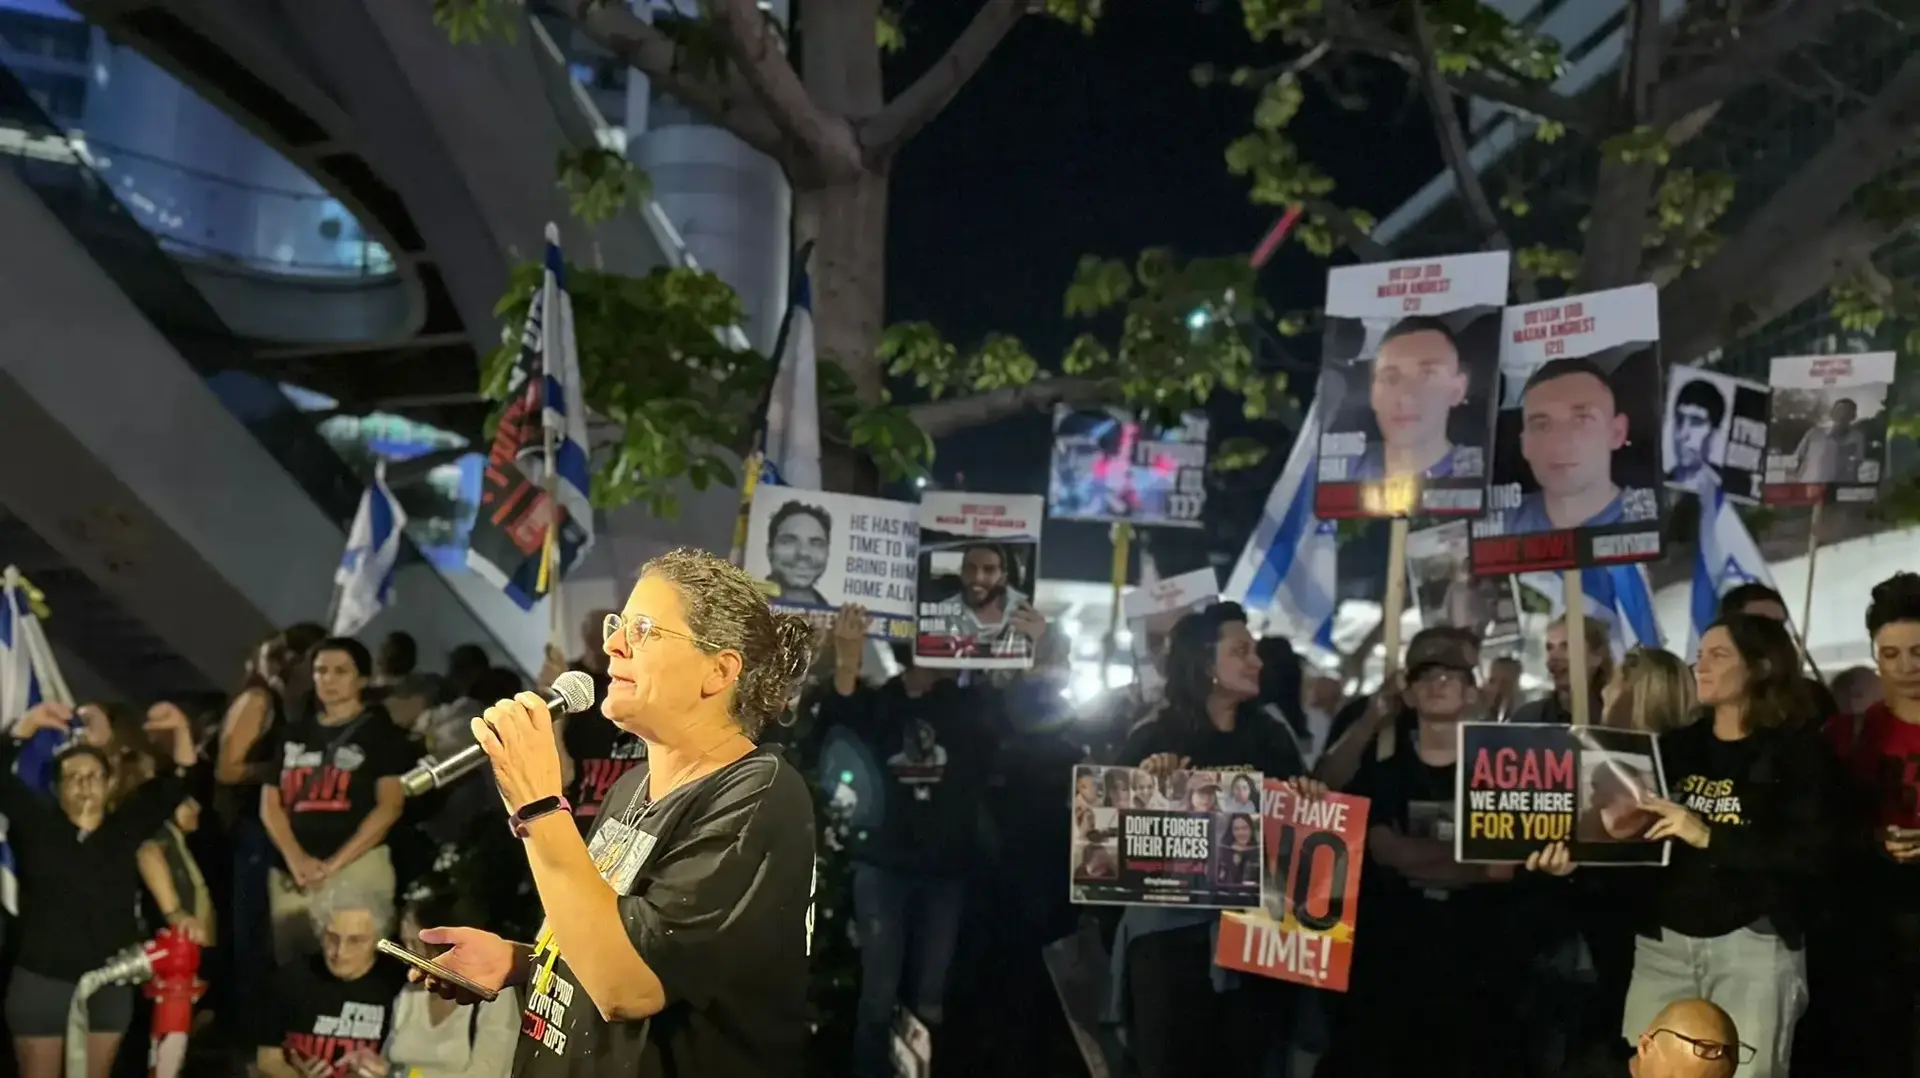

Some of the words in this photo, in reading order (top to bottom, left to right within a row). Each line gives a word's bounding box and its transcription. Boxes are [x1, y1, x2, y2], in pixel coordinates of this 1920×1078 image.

[850, 514, 868, 531] HE
[872, 517, 899, 534] HAS
[849, 535, 881, 553] TIME
[885, 539, 900, 556] TO
[846, 557, 886, 576] BRING
[890, 563, 916, 581] HIM
[843, 578, 883, 598] HOME
[886, 583, 915, 602] ALIV
[1471, 747, 1574, 790] AGAM
[1470, 791, 1496, 810] WE
[1498, 791, 1531, 811] ARE
[1533, 792, 1574, 812] HERE
[1125, 815, 1160, 835] DON'T
[1162, 817, 1209, 838] FORGET
[1292, 796, 1350, 833] HAVE
[1470, 812, 1514, 839] FOR
[1521, 813, 1573, 840] YOU!
[1126, 835, 1163, 857] THEIR
[1165, 837, 1209, 859] FACES
[1234, 918, 1332, 980] TIME!
